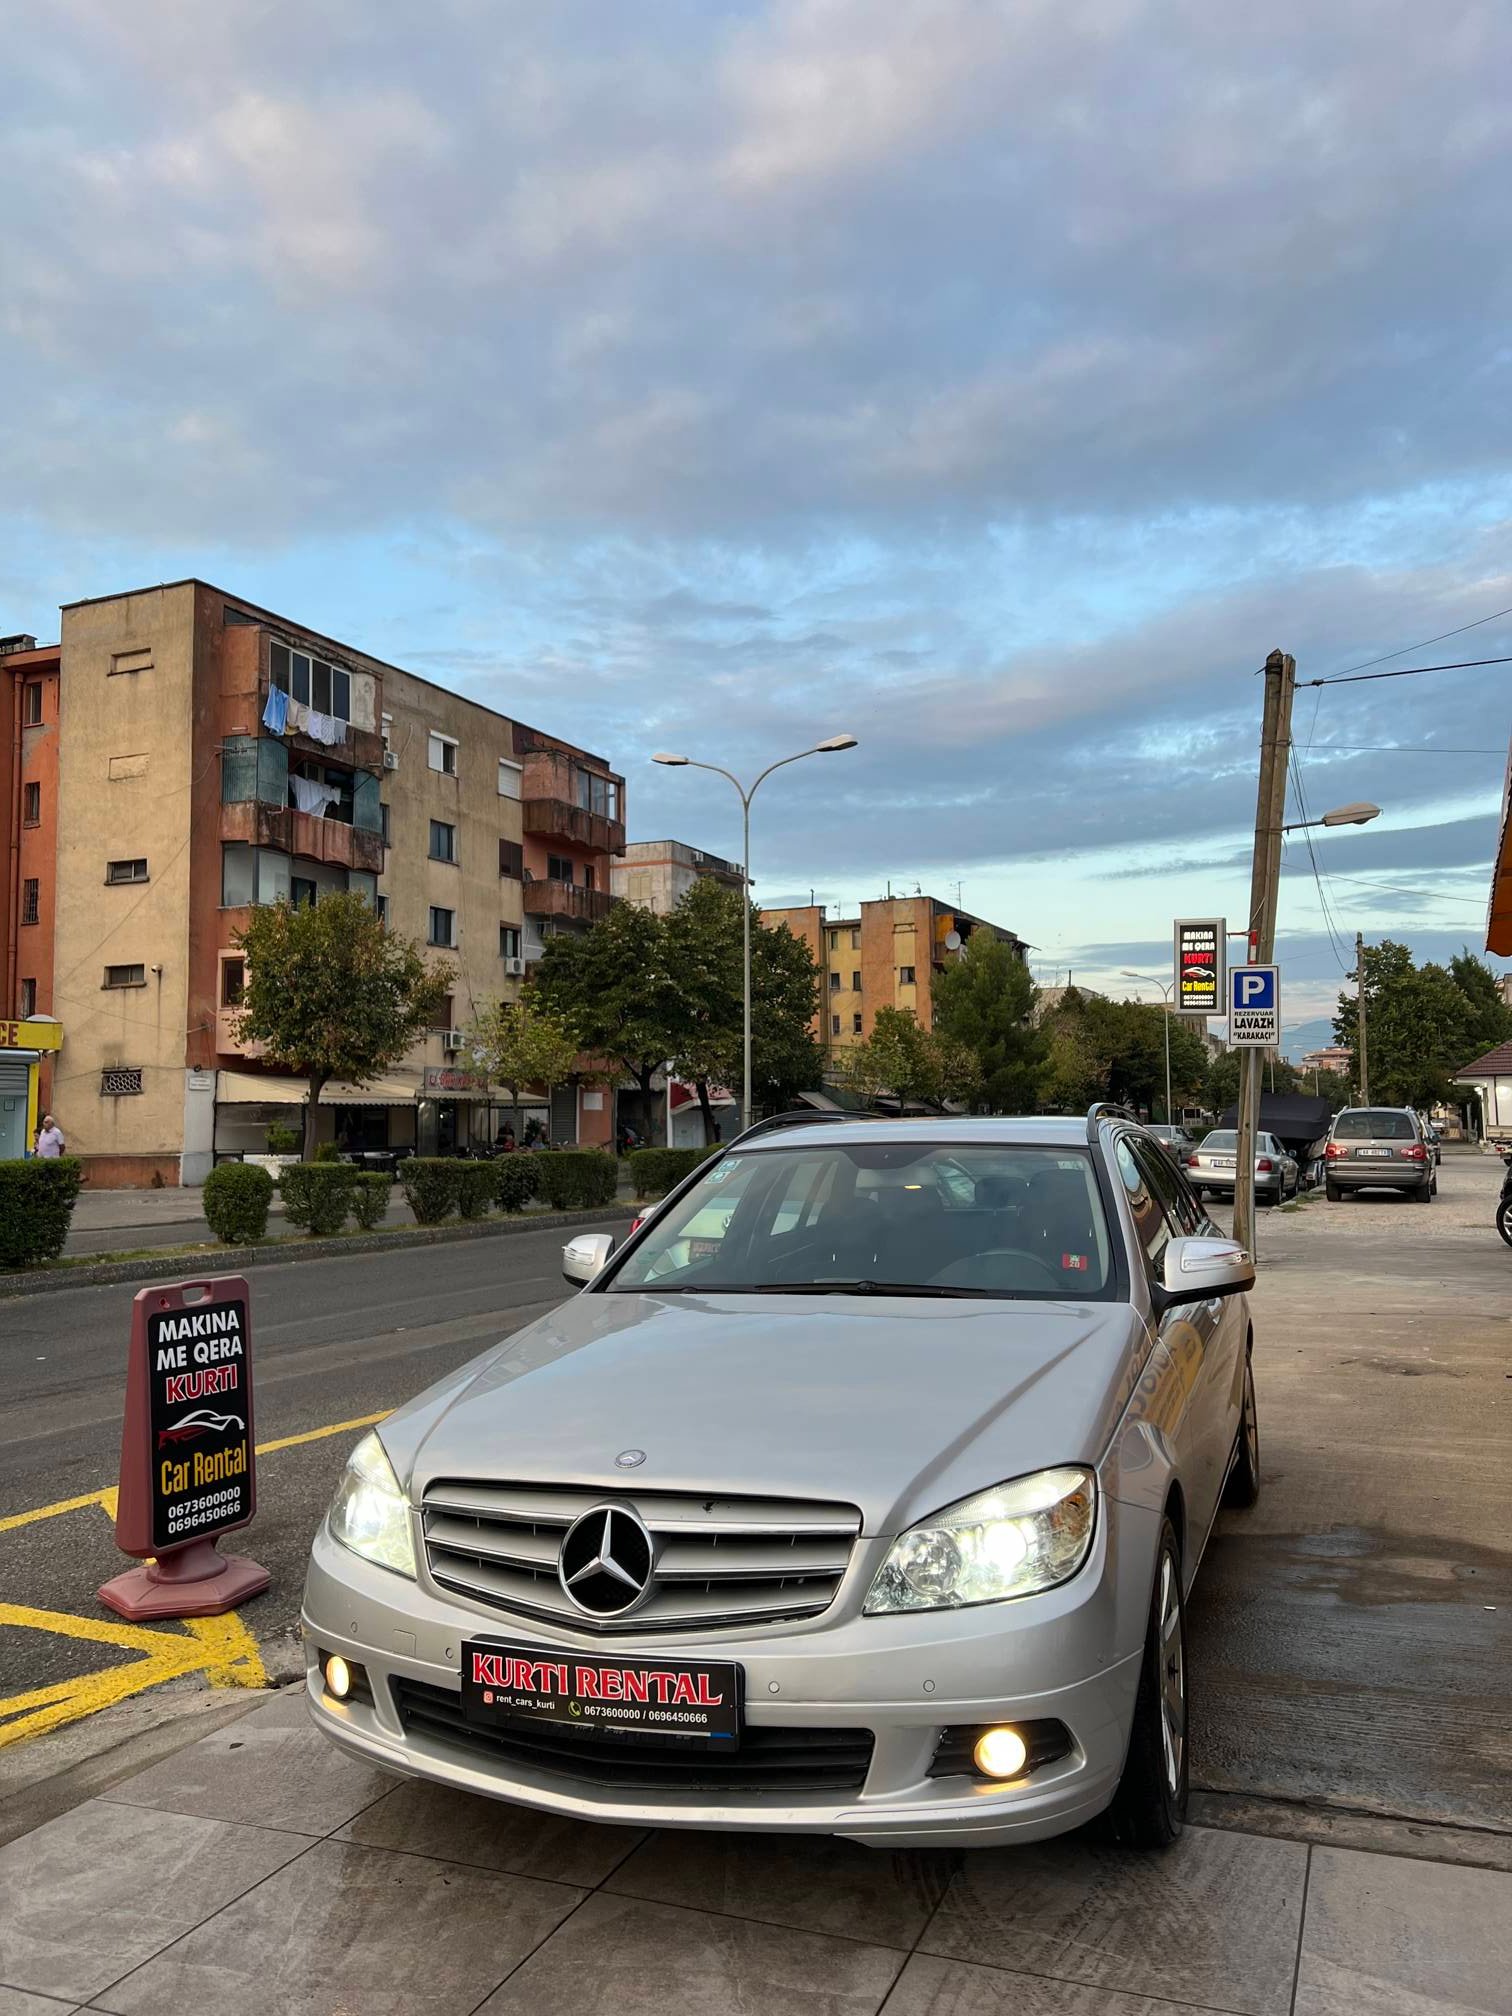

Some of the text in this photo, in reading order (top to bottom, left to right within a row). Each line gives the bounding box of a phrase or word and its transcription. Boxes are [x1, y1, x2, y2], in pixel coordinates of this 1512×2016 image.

[1182, 941, 1215, 951] ME QERA
[1183, 930, 1213, 940] MAKINA
[1183, 953, 1213, 964] KURTI
[1182, 980, 1215, 991] Car Rental
[1242, 976, 1265, 1005] P
[1234, 1018, 1274, 1028] LAVAZH
[158, 1310, 240, 1343] MAKINA
[157, 1335, 243, 1371] ME QERA
[166, 1363, 238, 1404] KURTI
[161, 1439, 246, 1495] Car Rental
[168, 1486, 241, 1519] 0673600000
[168, 1500, 241, 1534] 0696450666
[472, 1652, 723, 1705] KURTI RENTAL
[496, 1694, 555, 1710] rent_cars_kurti
[584, 1705, 640, 1719] 0673600000
[648, 1710, 708, 1723] 0696450666
